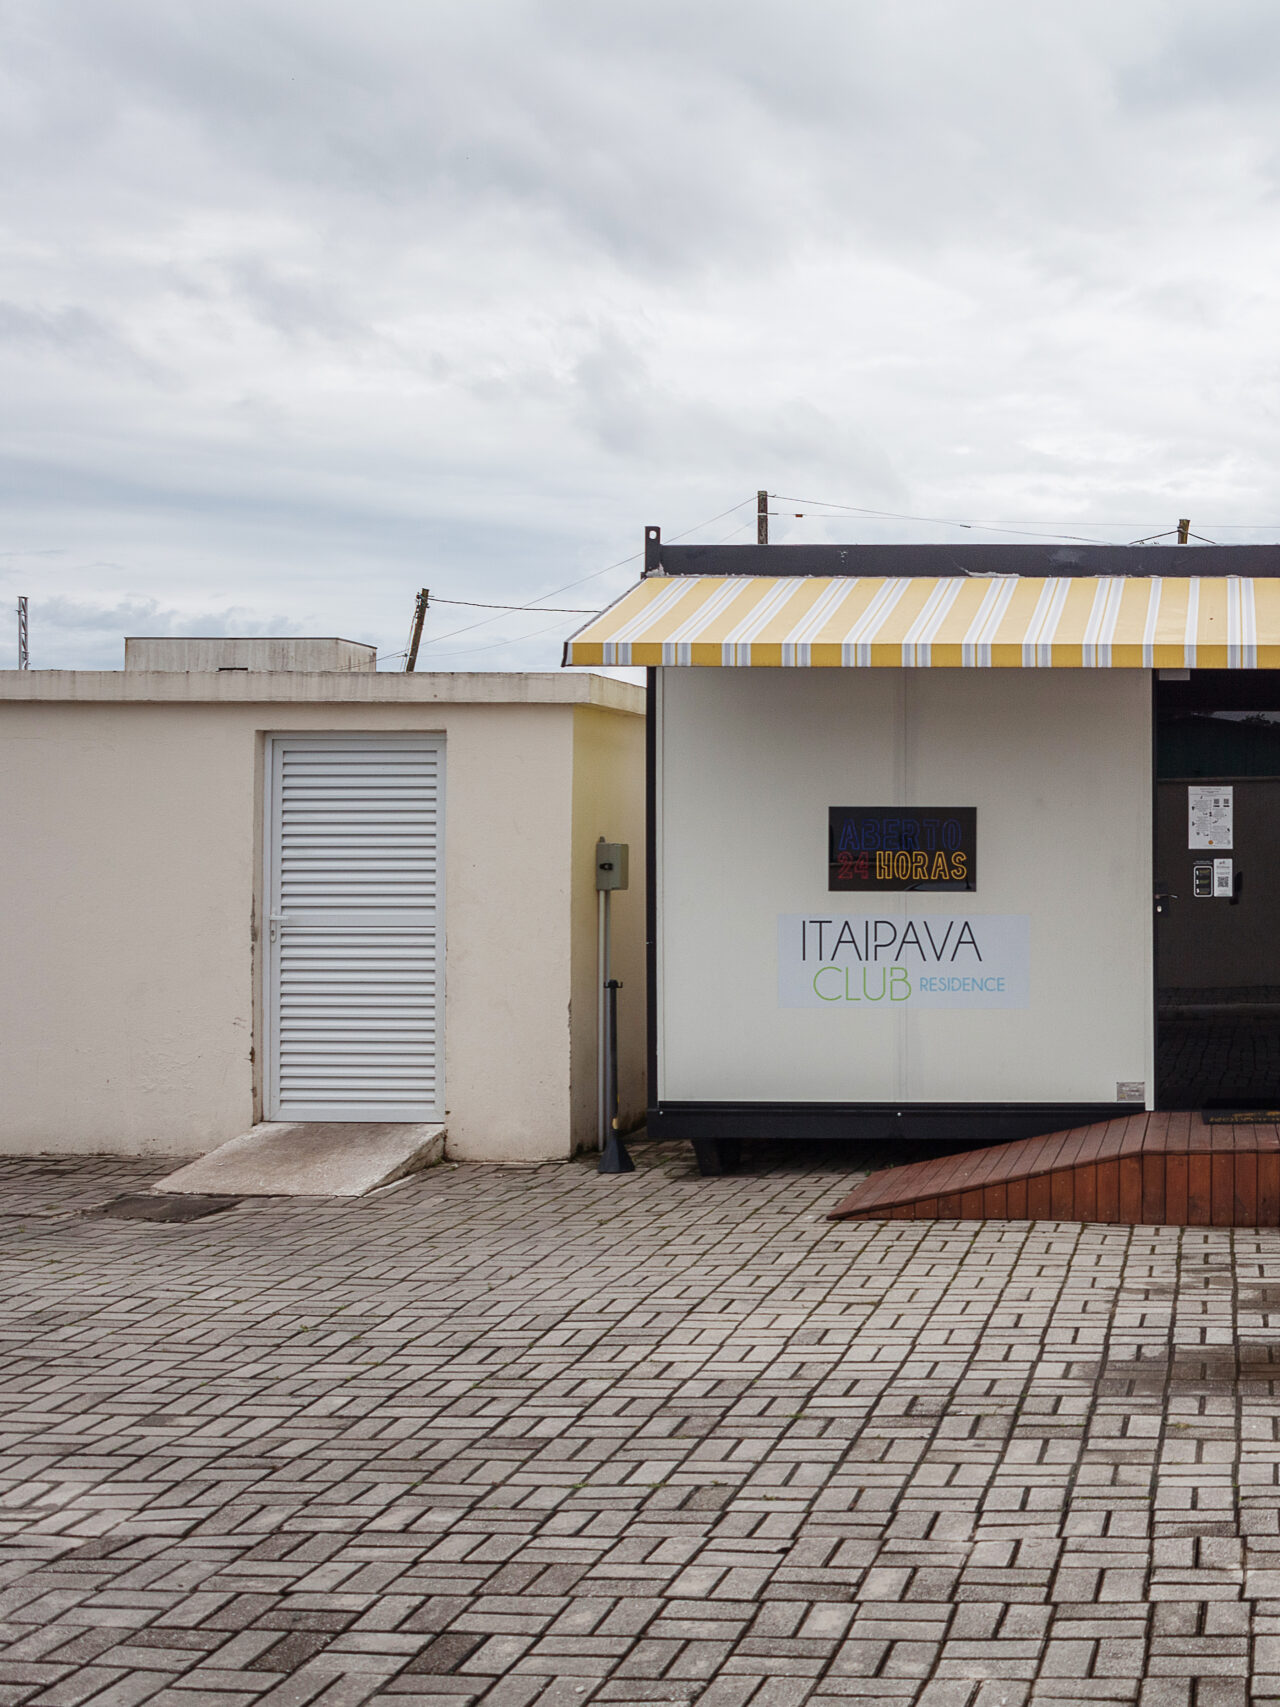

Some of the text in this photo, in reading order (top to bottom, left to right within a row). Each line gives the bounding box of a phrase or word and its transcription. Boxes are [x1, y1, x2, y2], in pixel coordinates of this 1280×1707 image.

[838, 818, 963, 851] ABERTO
[837, 851, 967, 880] 24 HORAS
[801, 920, 983, 962] ITAIPAVA
[813, 966, 1006, 1001] CLUB RESIDENCE
